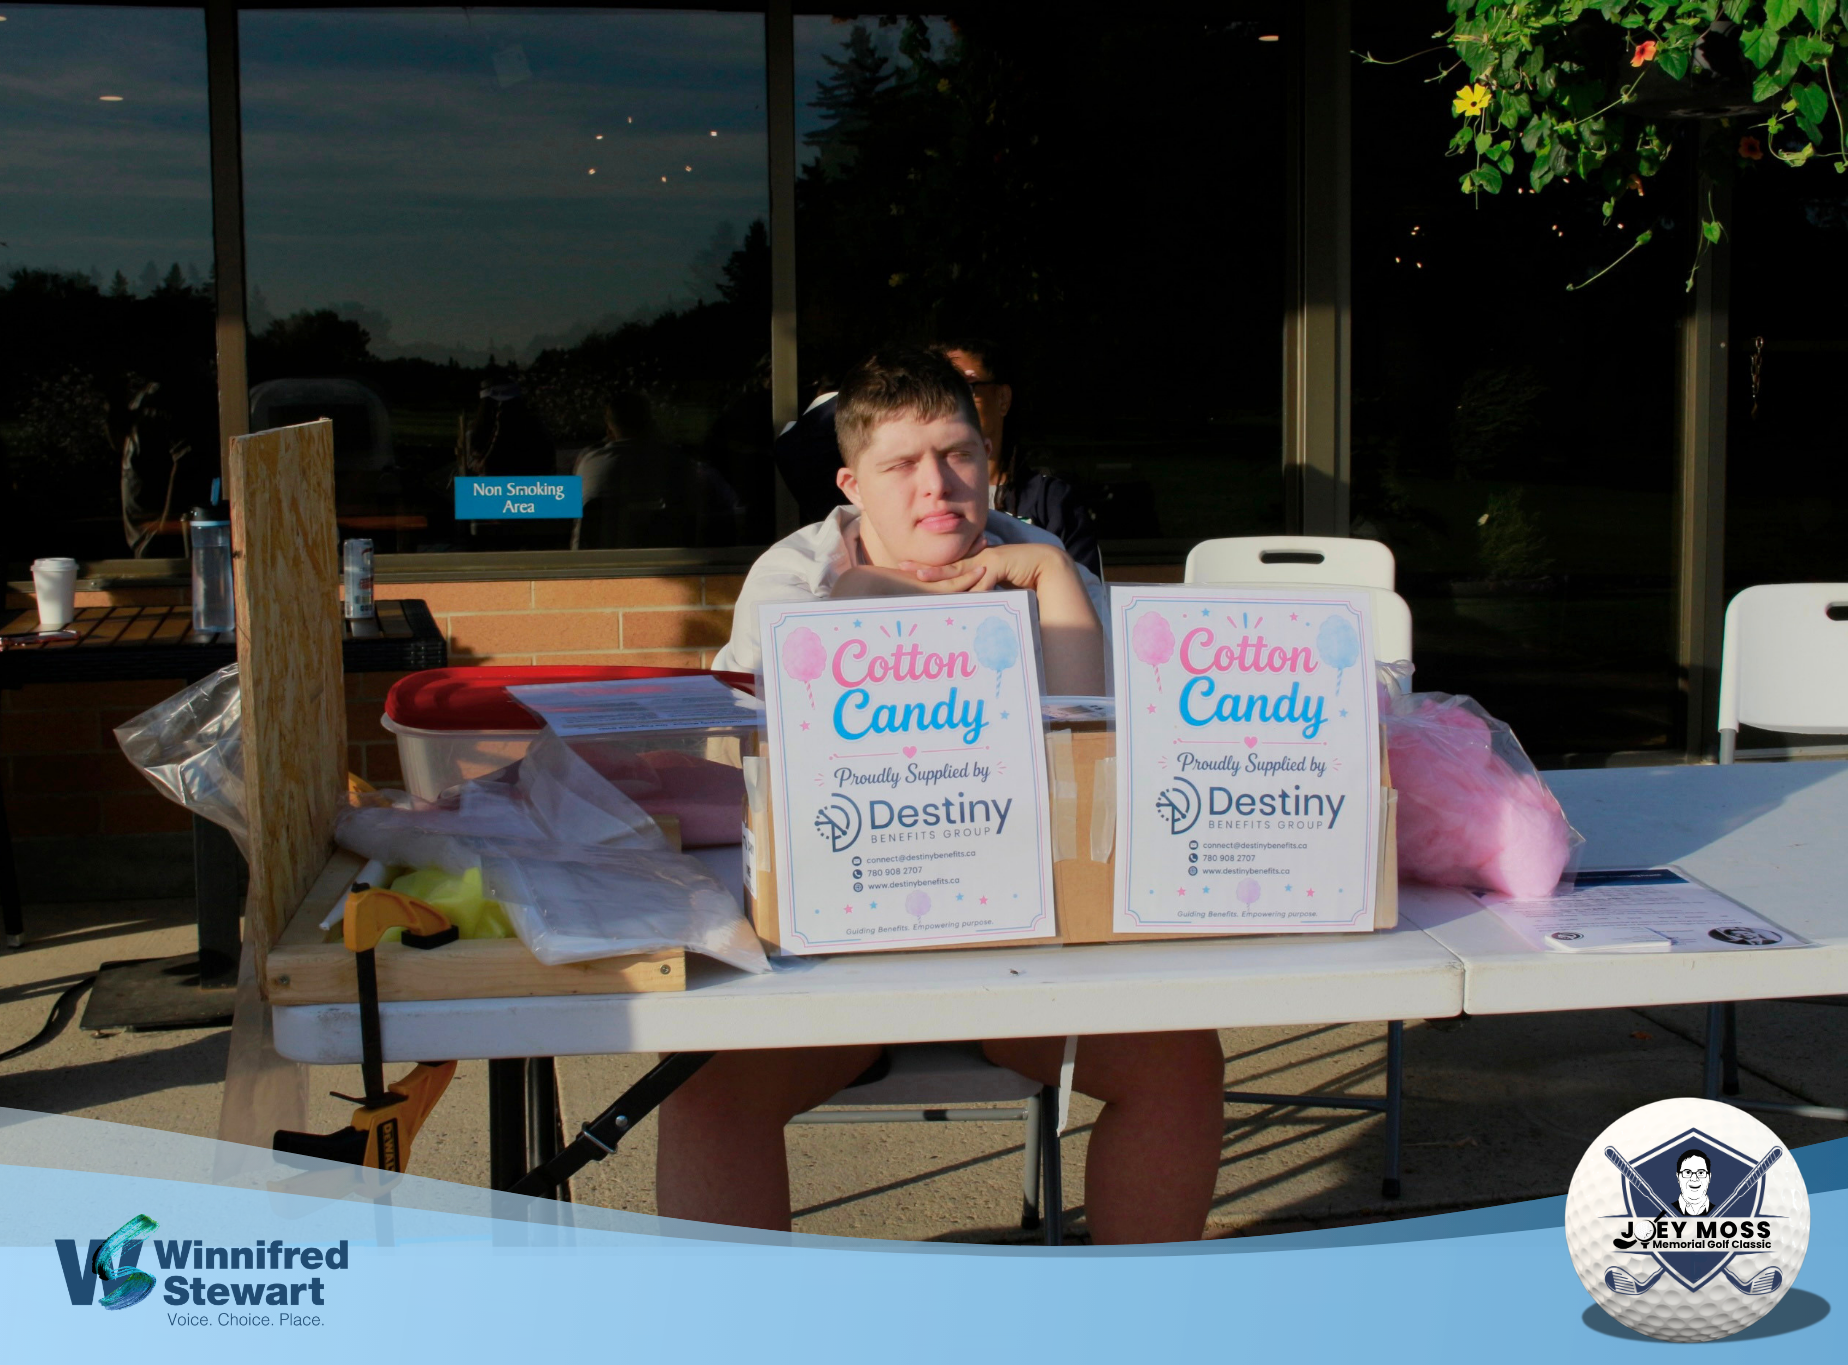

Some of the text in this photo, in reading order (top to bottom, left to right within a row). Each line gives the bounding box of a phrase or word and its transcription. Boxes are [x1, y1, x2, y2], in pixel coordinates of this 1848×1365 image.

[473, 482, 565, 500] Non Smoking
[502, 500, 535, 513] Area
[1179, 627, 1319, 675] Cotton
[831, 638, 977, 689] Cotton
[832, 686, 989, 745] Candy
[1179, 676, 1329, 740] Candy
[1177, 752, 1327, 778] Proudly Supplied by
[833, 761, 991, 789] Proudly Supplied by
[869, 791, 1013, 835] Destiny
[1209, 784, 1346, 830] Destiny
[1208, 820, 1323, 830] BENEFITS GROUP
[871, 827, 991, 844] BENEFITS GROUP
[1202, 842, 1308, 851] connect@destinybenefits.ca
[866, 850, 976, 864] connect@destinybenefits.ca
[1202, 854, 1256, 862] 780 908 2707
[867, 866, 923, 877] 780 908 2707
[1202, 867, 1290, 876] www.destinybenefits.ca
[868, 877, 960, 890] www.destinybenefits.ca
[1177, 911, 1206, 919] Guiding
[1241, 911, 1286, 919] Empowering
[1287, 911, 1318, 919] purpose.
[846, 919, 994, 936] Guiding Benefits. Empowering purpose.
